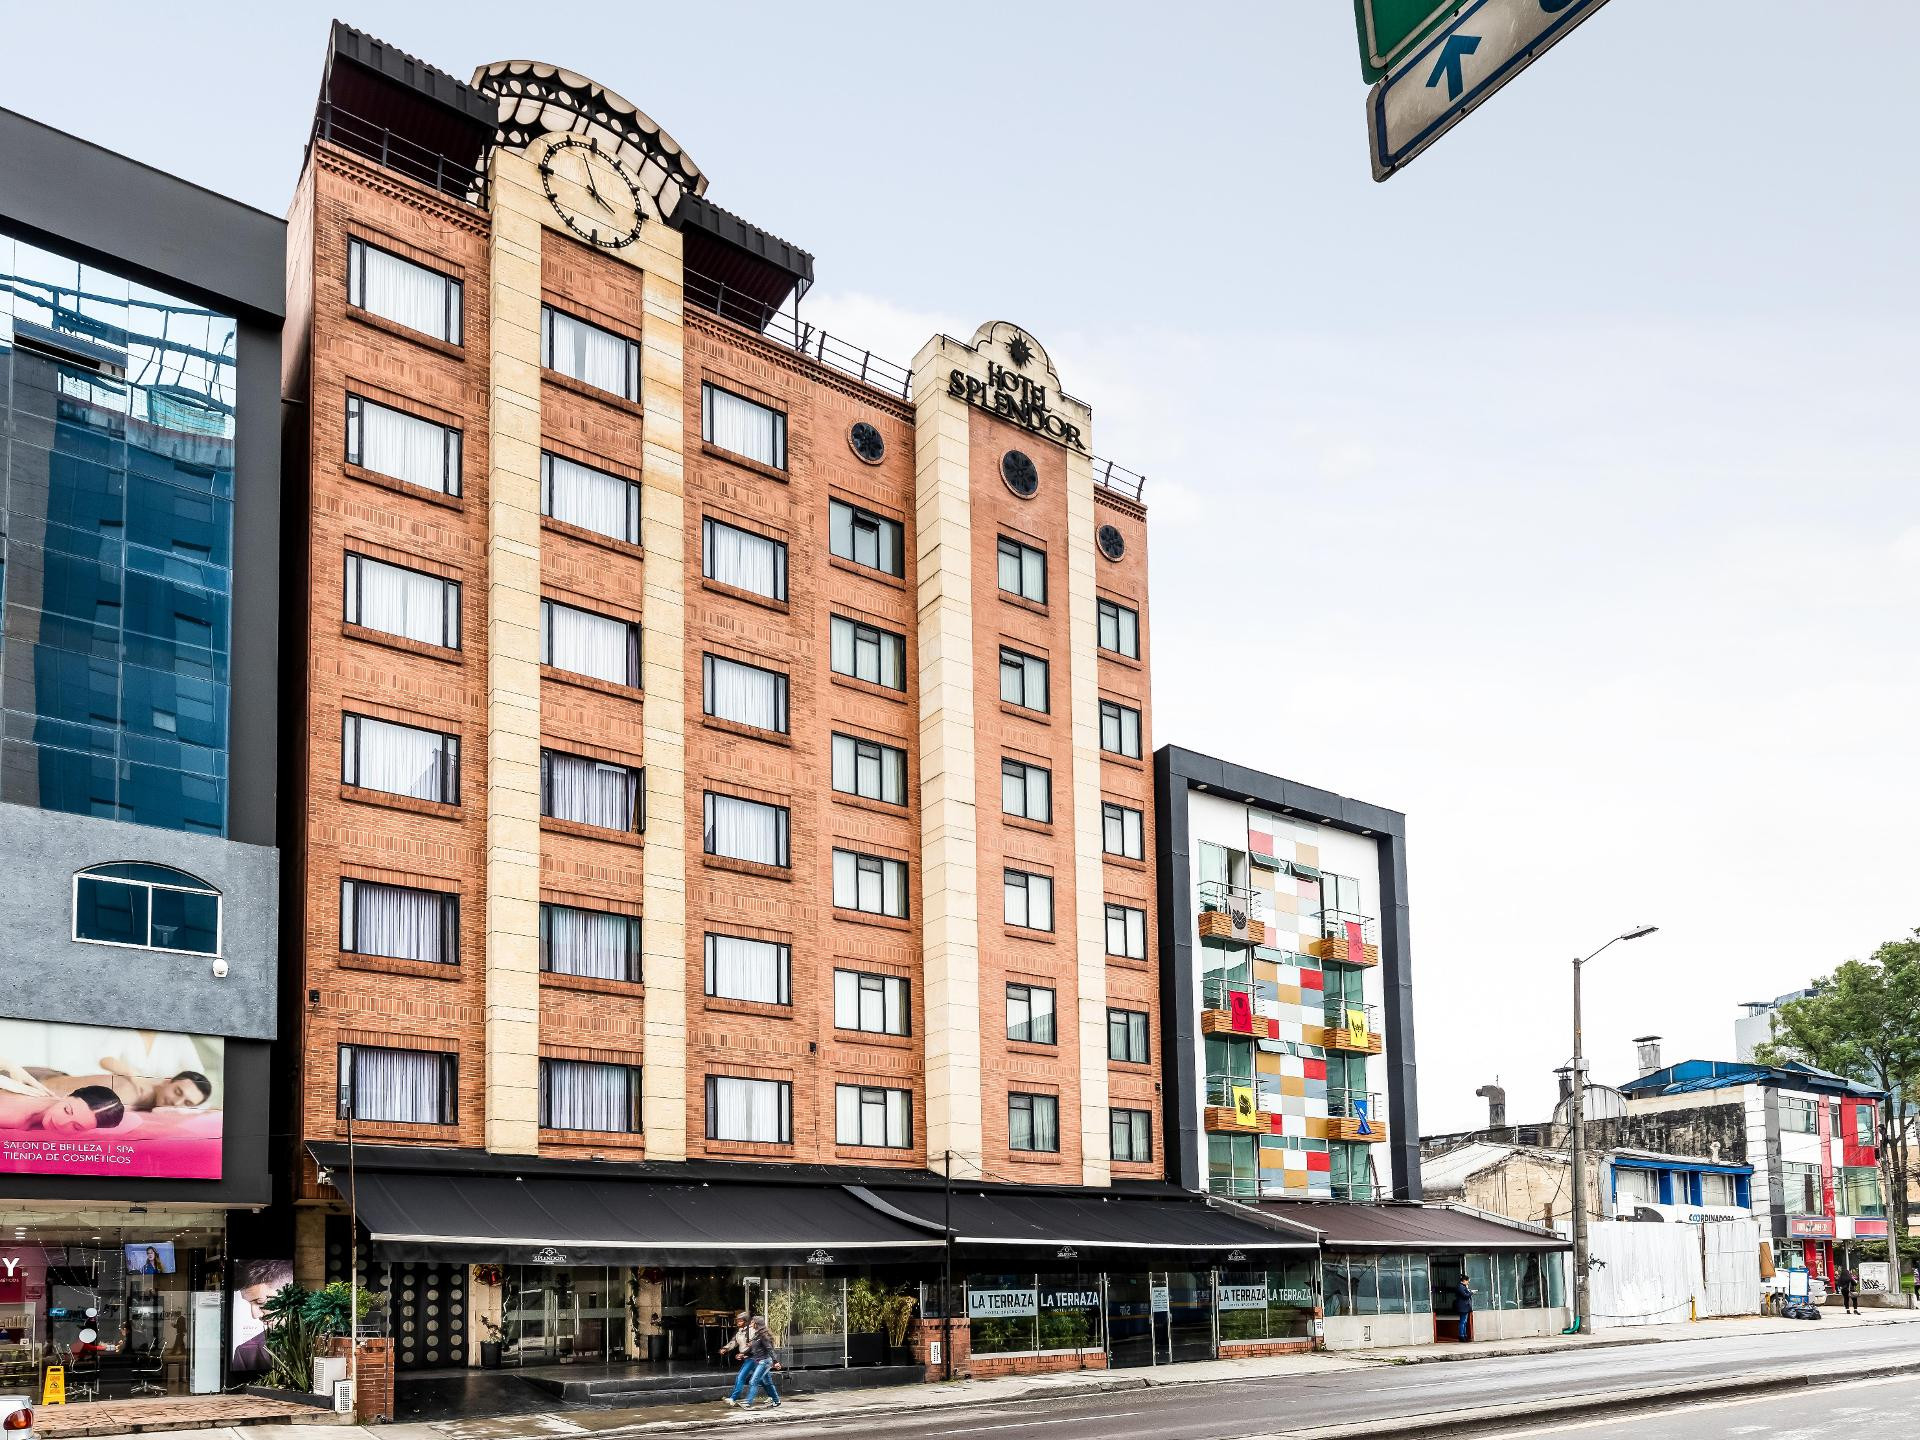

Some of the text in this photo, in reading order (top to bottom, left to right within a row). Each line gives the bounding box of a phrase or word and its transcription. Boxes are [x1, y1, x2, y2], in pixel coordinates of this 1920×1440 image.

[988, 361, 1052, 413] HOTEL
[949, 368, 1086, 451] SPLENDOR
[43, 1142, 57, 1151] DE
[60, 1143, 103, 1153] BELLEZA
[116, 1145, 135, 1154] SPA
[3, 1151, 131, 1164] TIENDA DE COSMÉTICOS
[2, 1257, 20, 1277] Y
[971, 1293, 1035, 1309] LA TERRAZA
[1040, 1291, 1099, 1307] LA TERRAZA
[1219, 1289, 1230, 1302] LA
[1231, 1288, 1267, 1302] TERRAZA
[1268, 1288, 1312, 1301] LA TERRAZA
